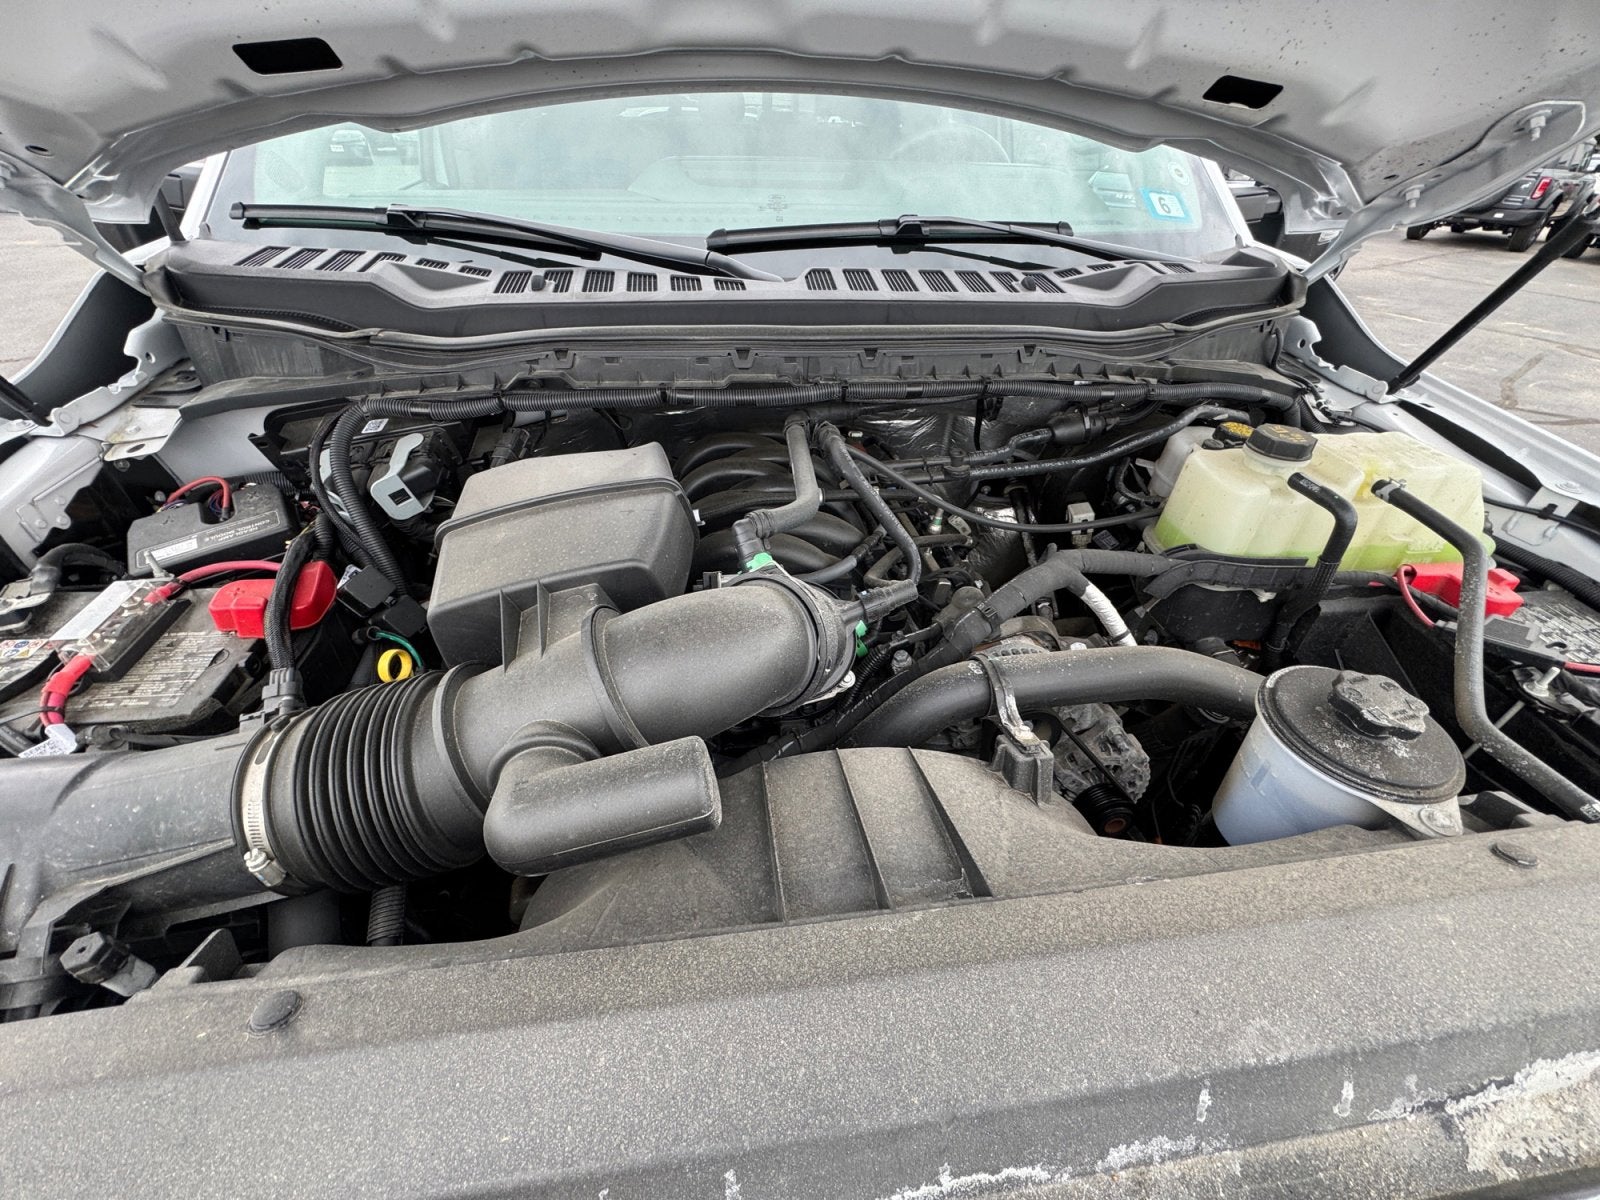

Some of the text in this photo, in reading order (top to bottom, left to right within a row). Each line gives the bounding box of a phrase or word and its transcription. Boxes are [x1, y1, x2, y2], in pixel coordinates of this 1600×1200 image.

[1158, 196, 1171, 214] 6
[204, 519, 270, 541] CONTROL MODULE
